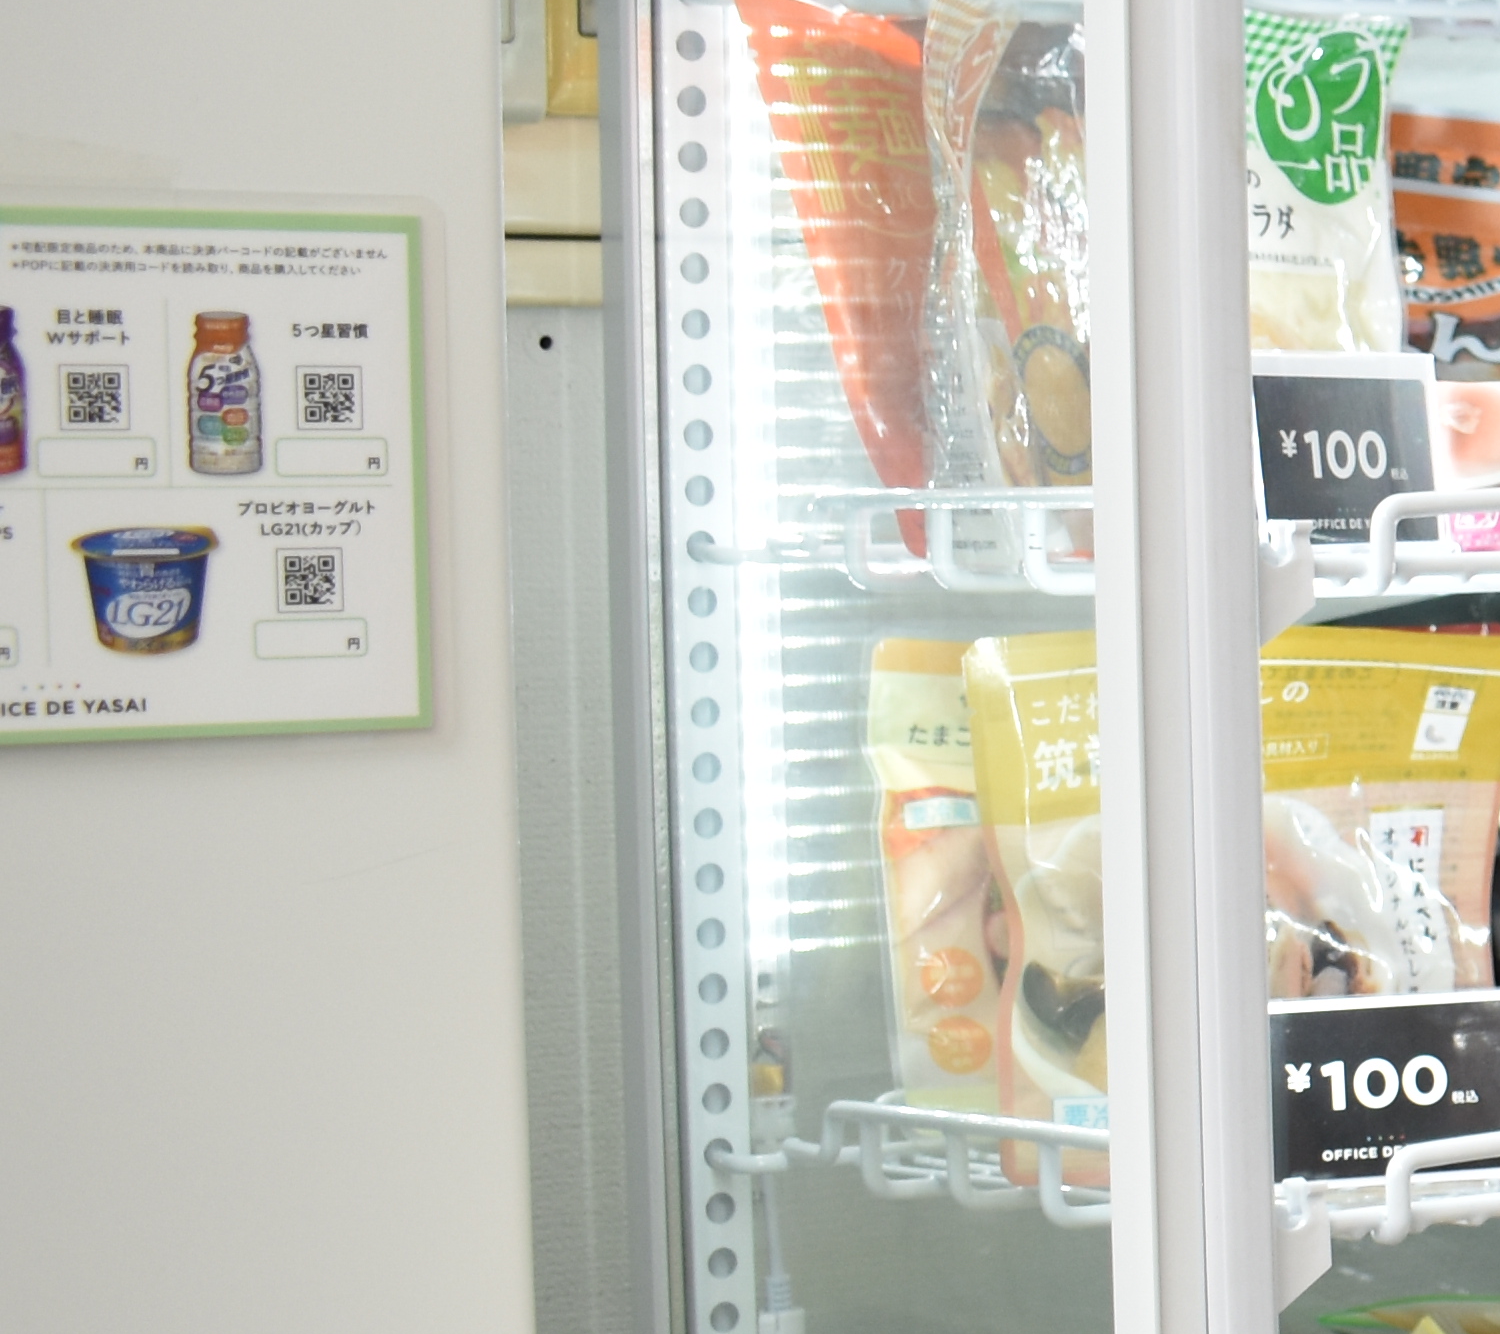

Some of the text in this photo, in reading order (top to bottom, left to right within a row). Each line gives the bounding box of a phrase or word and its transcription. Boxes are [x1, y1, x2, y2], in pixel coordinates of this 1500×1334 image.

[56, 308, 124, 327] 目と睡眠
[47, 329, 131, 347] Wサポート
[292, 321, 369, 341] 5つ星習慣
[367, 456, 381, 471] 円
[1279, 428, 1388, 481] ¥100
[135, 456, 149, 472] 円
[237, 500, 377, 517] プロビオヨーグルト
[260, 520, 364, 538] LG21(カップ)
[109, 597, 186, 628] LG21
[346, 636, 361, 652] 円
[0, 698, 148, 717] ICE DE YASAI
[1285, 1054, 1480, 1113] ¥100 税込
[1321, 1145, 1379, 1162] OFFICE
